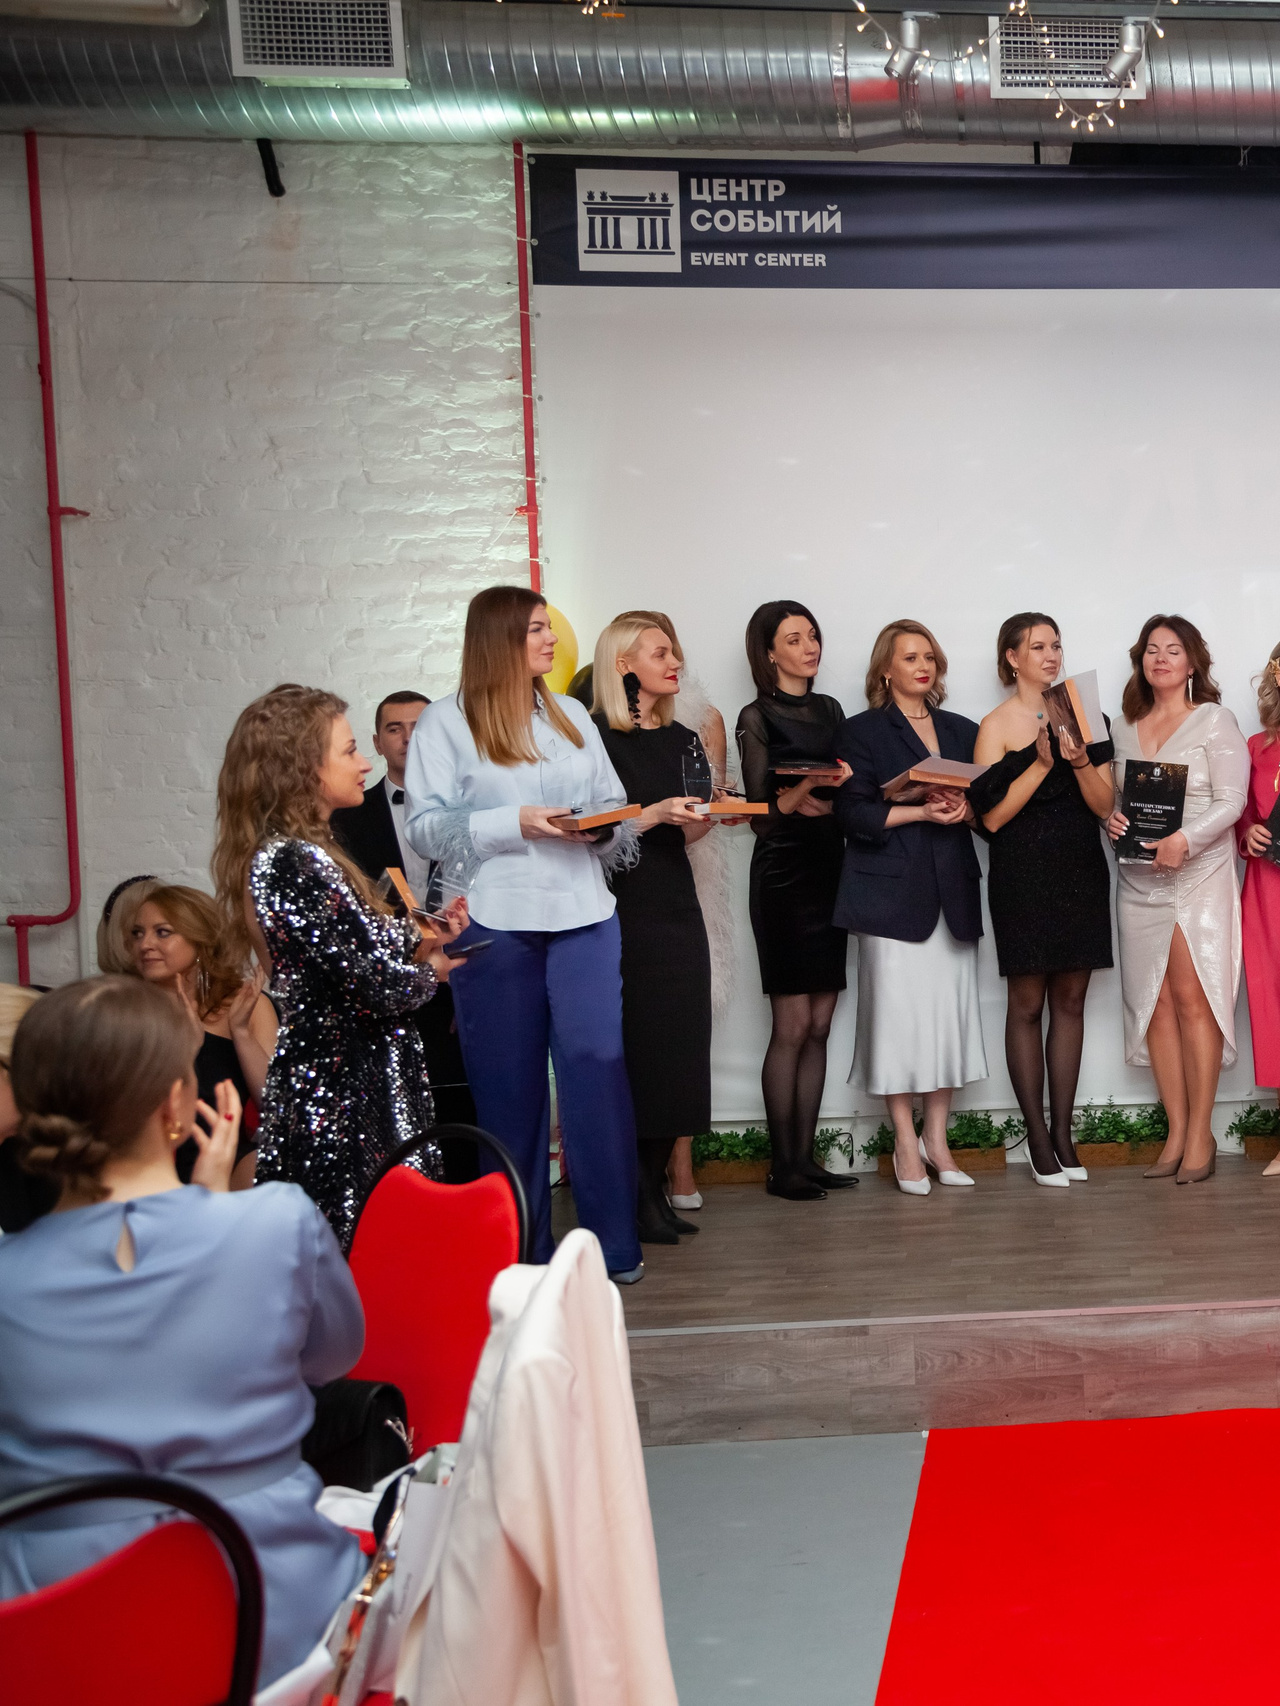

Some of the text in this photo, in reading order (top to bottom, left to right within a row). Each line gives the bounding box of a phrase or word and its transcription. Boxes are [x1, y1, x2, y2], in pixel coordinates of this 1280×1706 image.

[690, 178, 786, 203] ЦЕНТР
[690, 204, 842, 234] СОБЫТИЙ
[690, 252, 827, 267] EVENT CENTER
